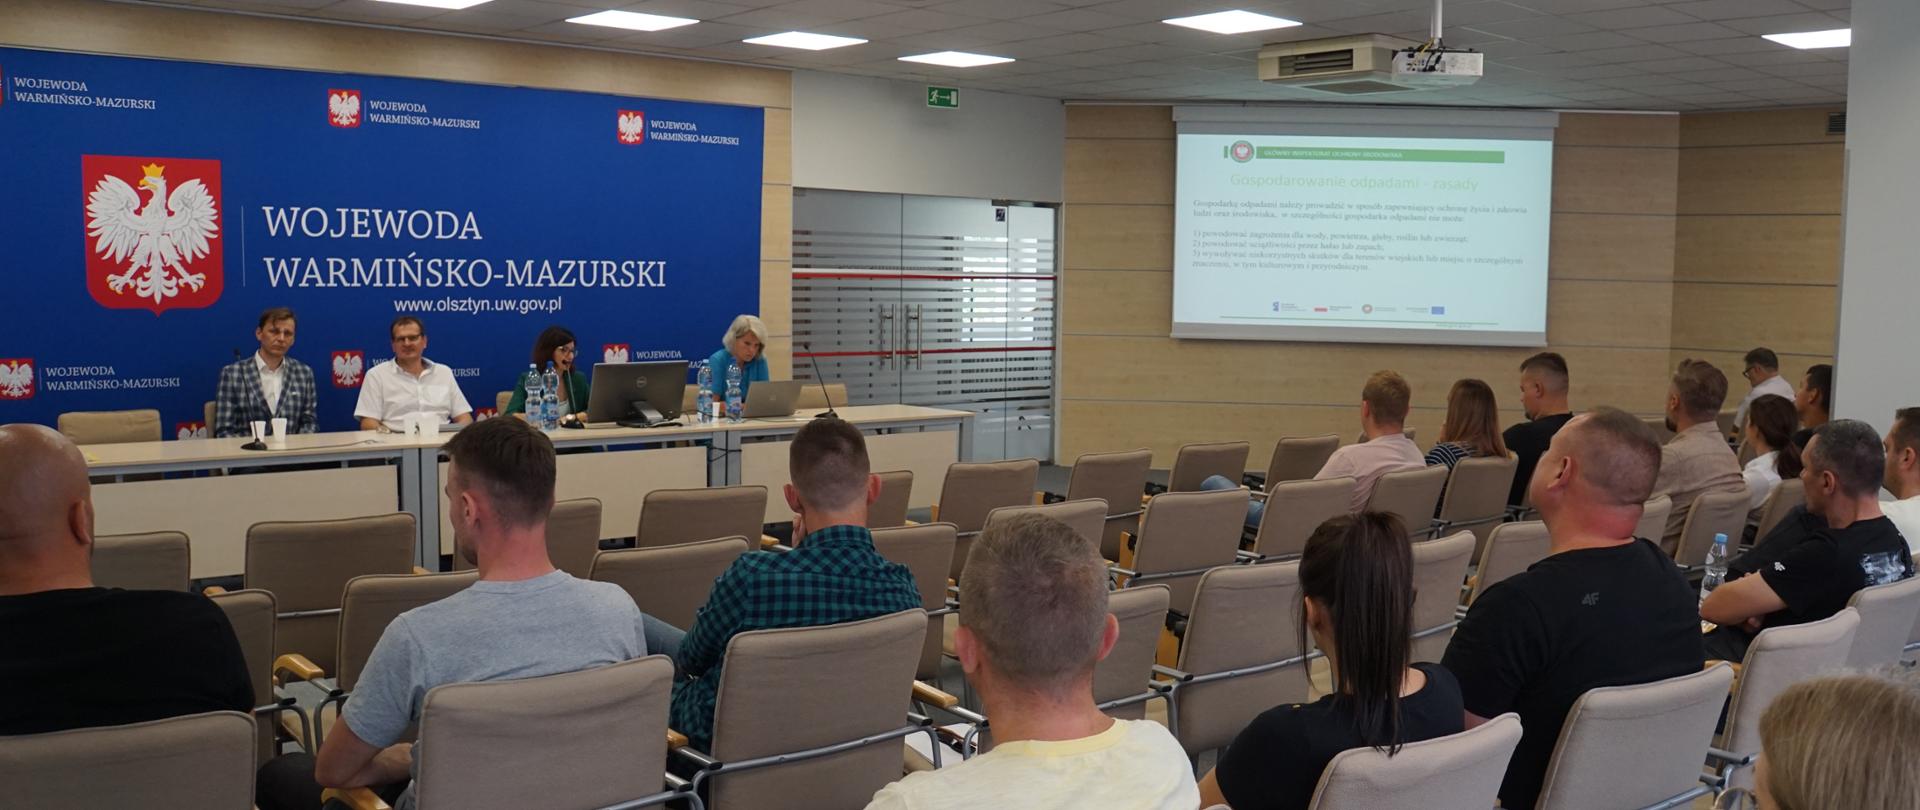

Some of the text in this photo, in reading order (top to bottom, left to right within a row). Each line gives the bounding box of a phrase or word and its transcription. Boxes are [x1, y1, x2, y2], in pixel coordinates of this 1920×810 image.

[14, 77, 88, 92] WOJEWODA
[14, 91, 156, 110] WARMIŃSKO-MAZURSKI
[370, 100, 427, 113] WOJEWODA
[370, 113, 480, 129] WARMIŃSKO-MAZURSKI
[650, 120, 697, 132] WOJEWODA
[650, 131, 740, 146] WARMIŃSKO-MAZURSKI
[1230, 173, 1346, 189] Gospodarowanie
[1351, 175, 1420, 190] odpadami
[1433, 176, 1479, 192] zasady
[262, 206, 483, 240] WOJEWODA
[262, 252, 667, 288] WARMIŃSKO-MAZURSKI
[394, 296, 562, 315] www.olsztyn.uw.gov.pl
[635, 350, 683, 360] WOJEWODA
[46, 366, 116, 377] WOJEWODA
[46, 377, 181, 391] WARMIŃSKO-MAZURSKI
